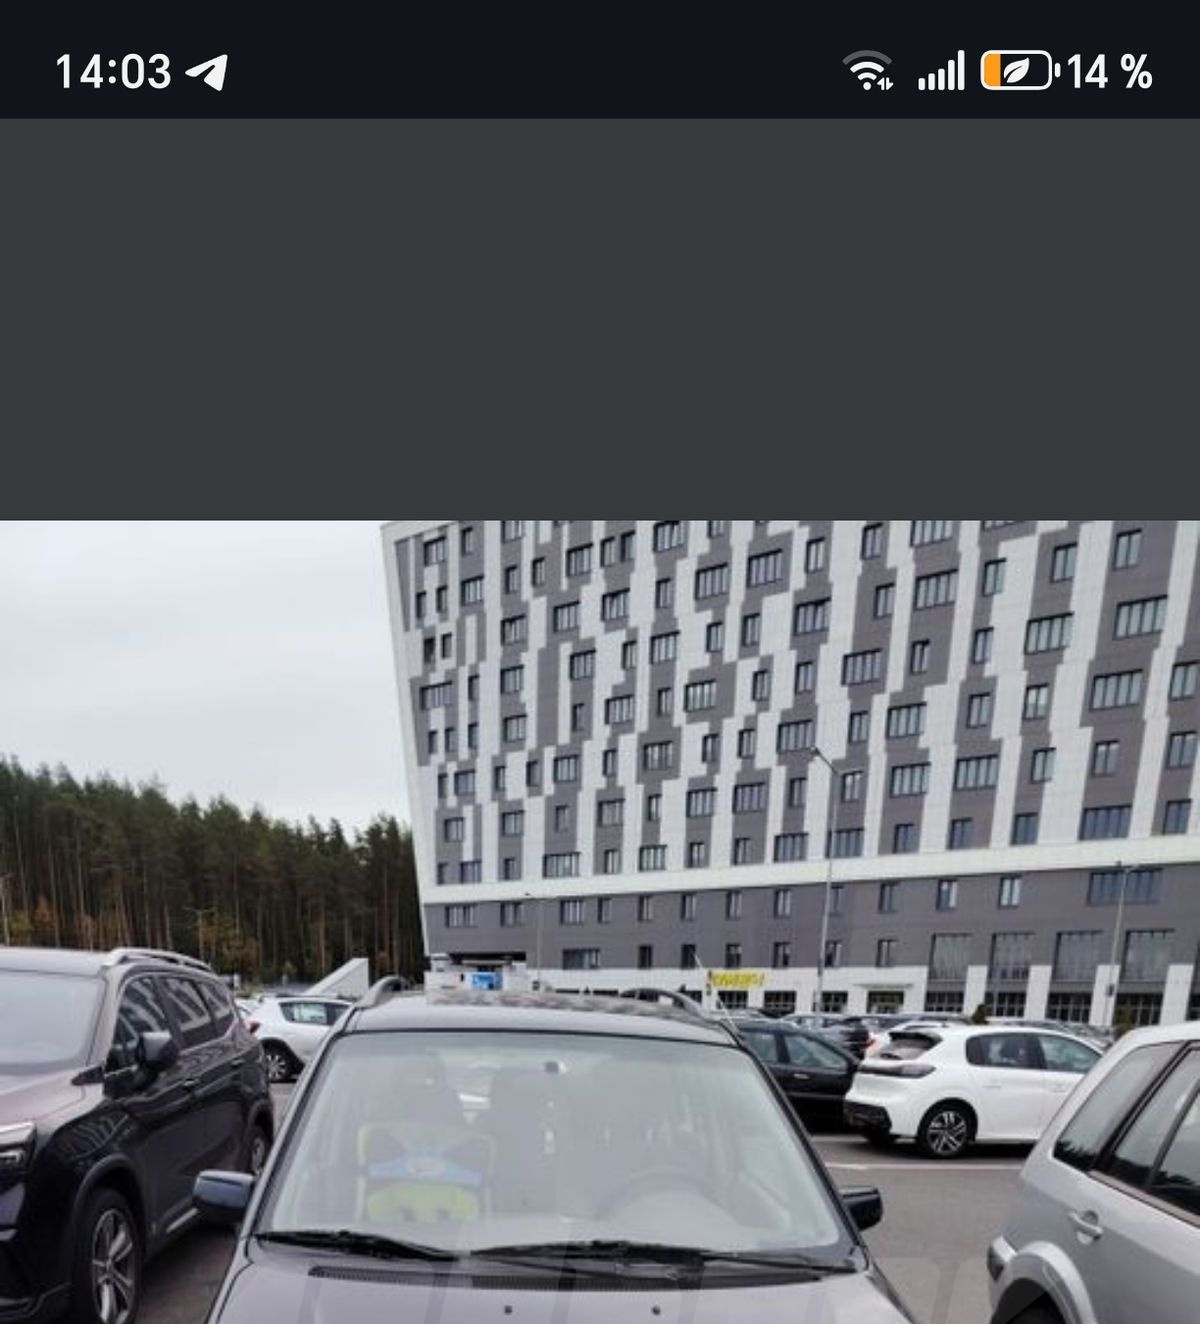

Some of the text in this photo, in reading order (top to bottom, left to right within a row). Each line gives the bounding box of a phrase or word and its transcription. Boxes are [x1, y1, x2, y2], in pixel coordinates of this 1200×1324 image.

[56, 53, 170, 89] 14:03
[1067, 53, 1152, 88] 14 %
